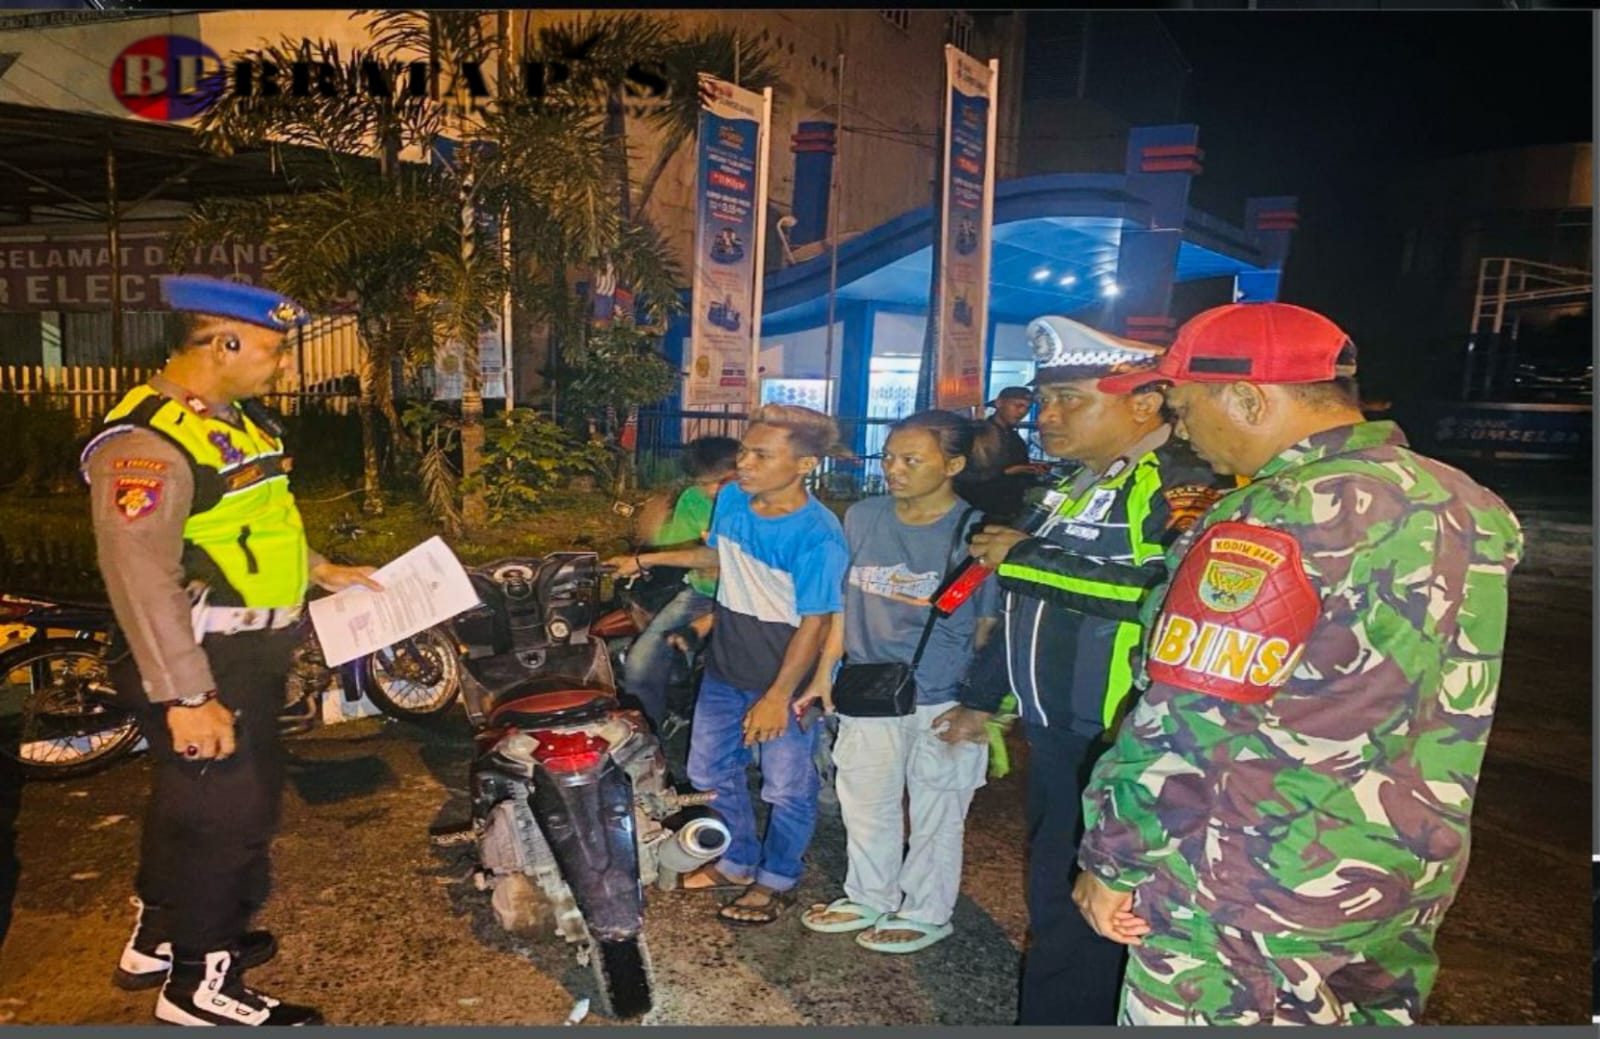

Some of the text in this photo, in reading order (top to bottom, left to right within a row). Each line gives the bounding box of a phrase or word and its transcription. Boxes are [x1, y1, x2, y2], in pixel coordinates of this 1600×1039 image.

[0, 243, 278, 270] SELAMAT DTANG
[1215, 540, 1252, 553] KODIM
[1151, 614, 1305, 687] BINS
